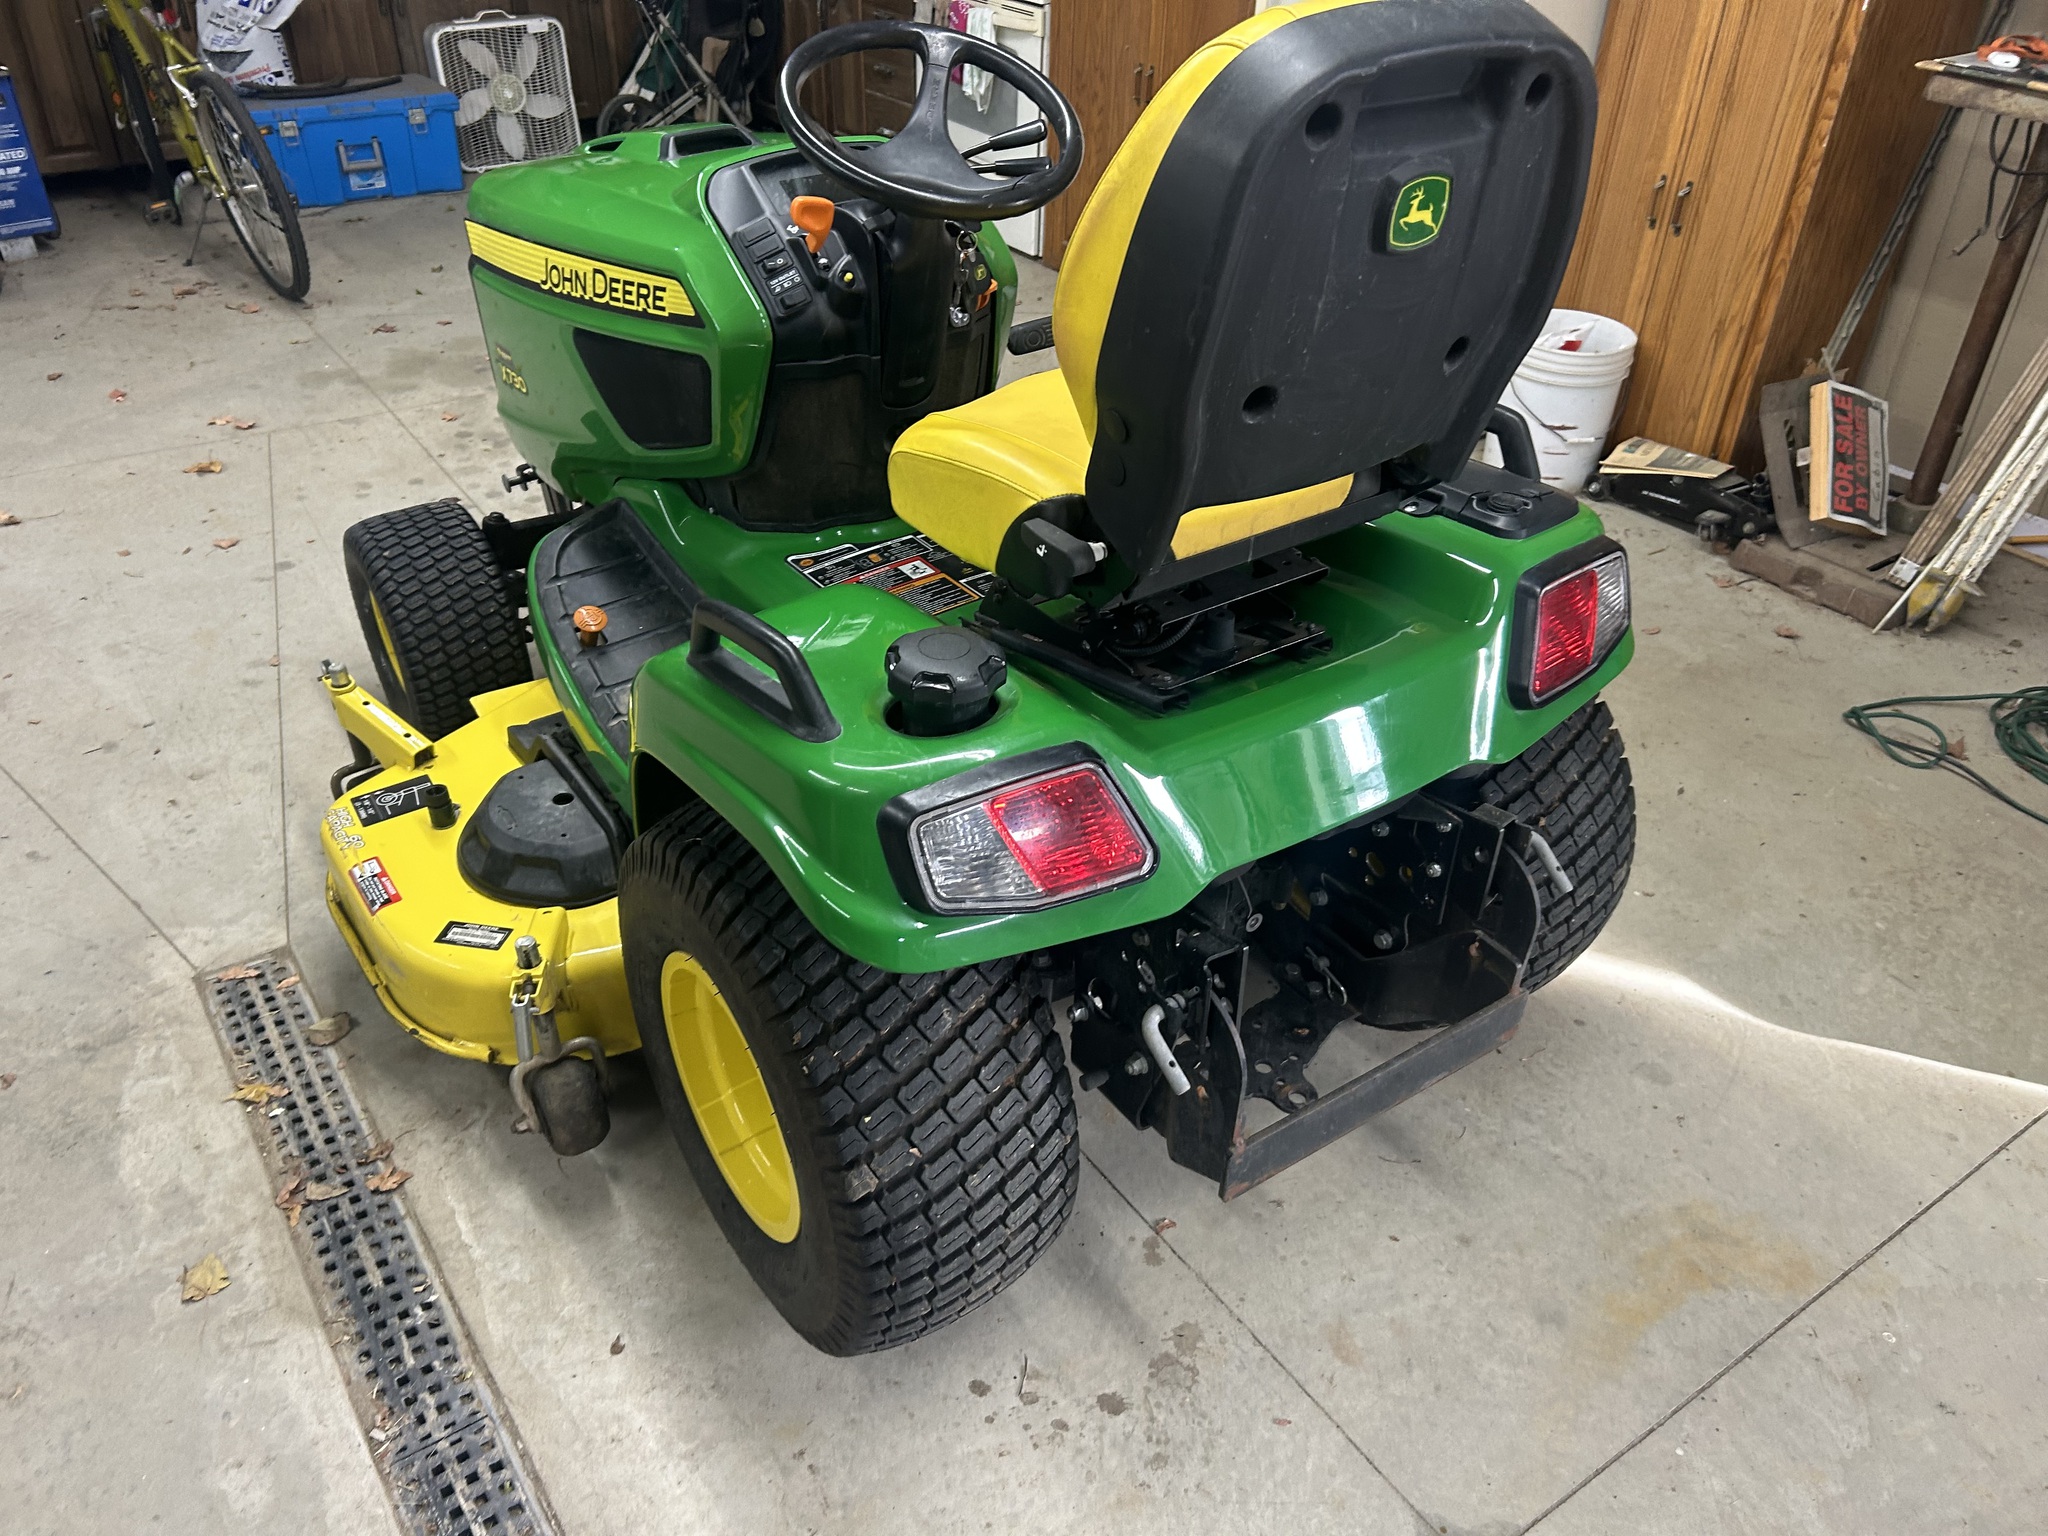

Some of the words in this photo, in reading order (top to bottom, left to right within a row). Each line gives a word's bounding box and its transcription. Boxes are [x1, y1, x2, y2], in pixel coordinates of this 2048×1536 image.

[540, 258, 587, 296] JOHN
[592, 268, 667, 312] DEERE
[1833, 394, 1853, 456] SALE
[1855, 404, 1868, 477] OWNER
[1833, 461, 1854, 513] FOR
[1855, 482, 1868, 512] BY
[336, 807, 356, 828] HIGH
[349, 834, 365, 850] 60
